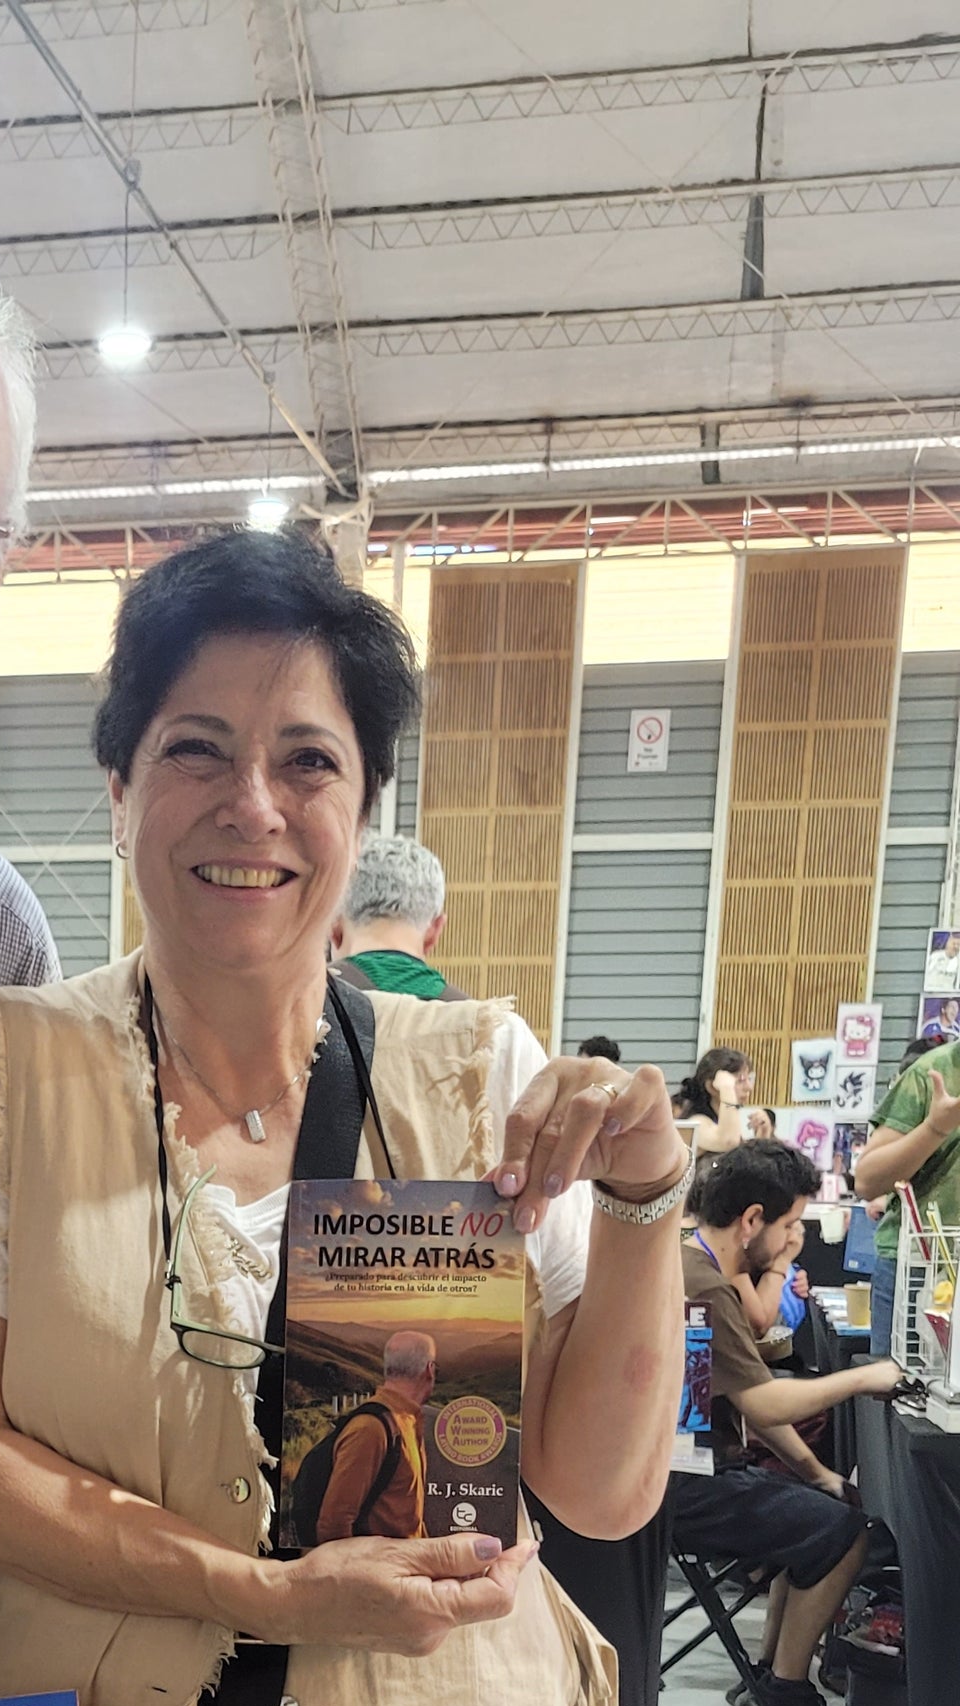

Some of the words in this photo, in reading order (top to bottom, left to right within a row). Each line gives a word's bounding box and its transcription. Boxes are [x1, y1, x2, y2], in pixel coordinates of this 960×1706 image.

[314, 1214, 454, 1236] IMPOSIBLE
[460, 1212, 503, 1238] NO
[318, 1246, 405, 1267] MIRAR
[412, 1242, 495, 1268] ATRÁS
[326, 1273, 375, 1283] ¿Preparado
[376, 1275, 395, 1283] para
[398, 1273, 439, 1281] descubrir
[442, 1273, 450, 1281] el
[452, 1274, 487, 1283] impacto
[334, 1283, 345, 1291] de
[358, 1282, 392, 1292] historia
[394, 1284, 404, 1292] en
[407, 1283, 414, 1292] la
[417, 1283, 435, 1292] vida
[438, 1283, 448, 1292] de
[450, 1284, 477, 1293] otros?
[427, 1483, 442, 1495] R.
[445, 1483, 456, 1498] J.
[459, 1483, 504, 1496] Skaric
